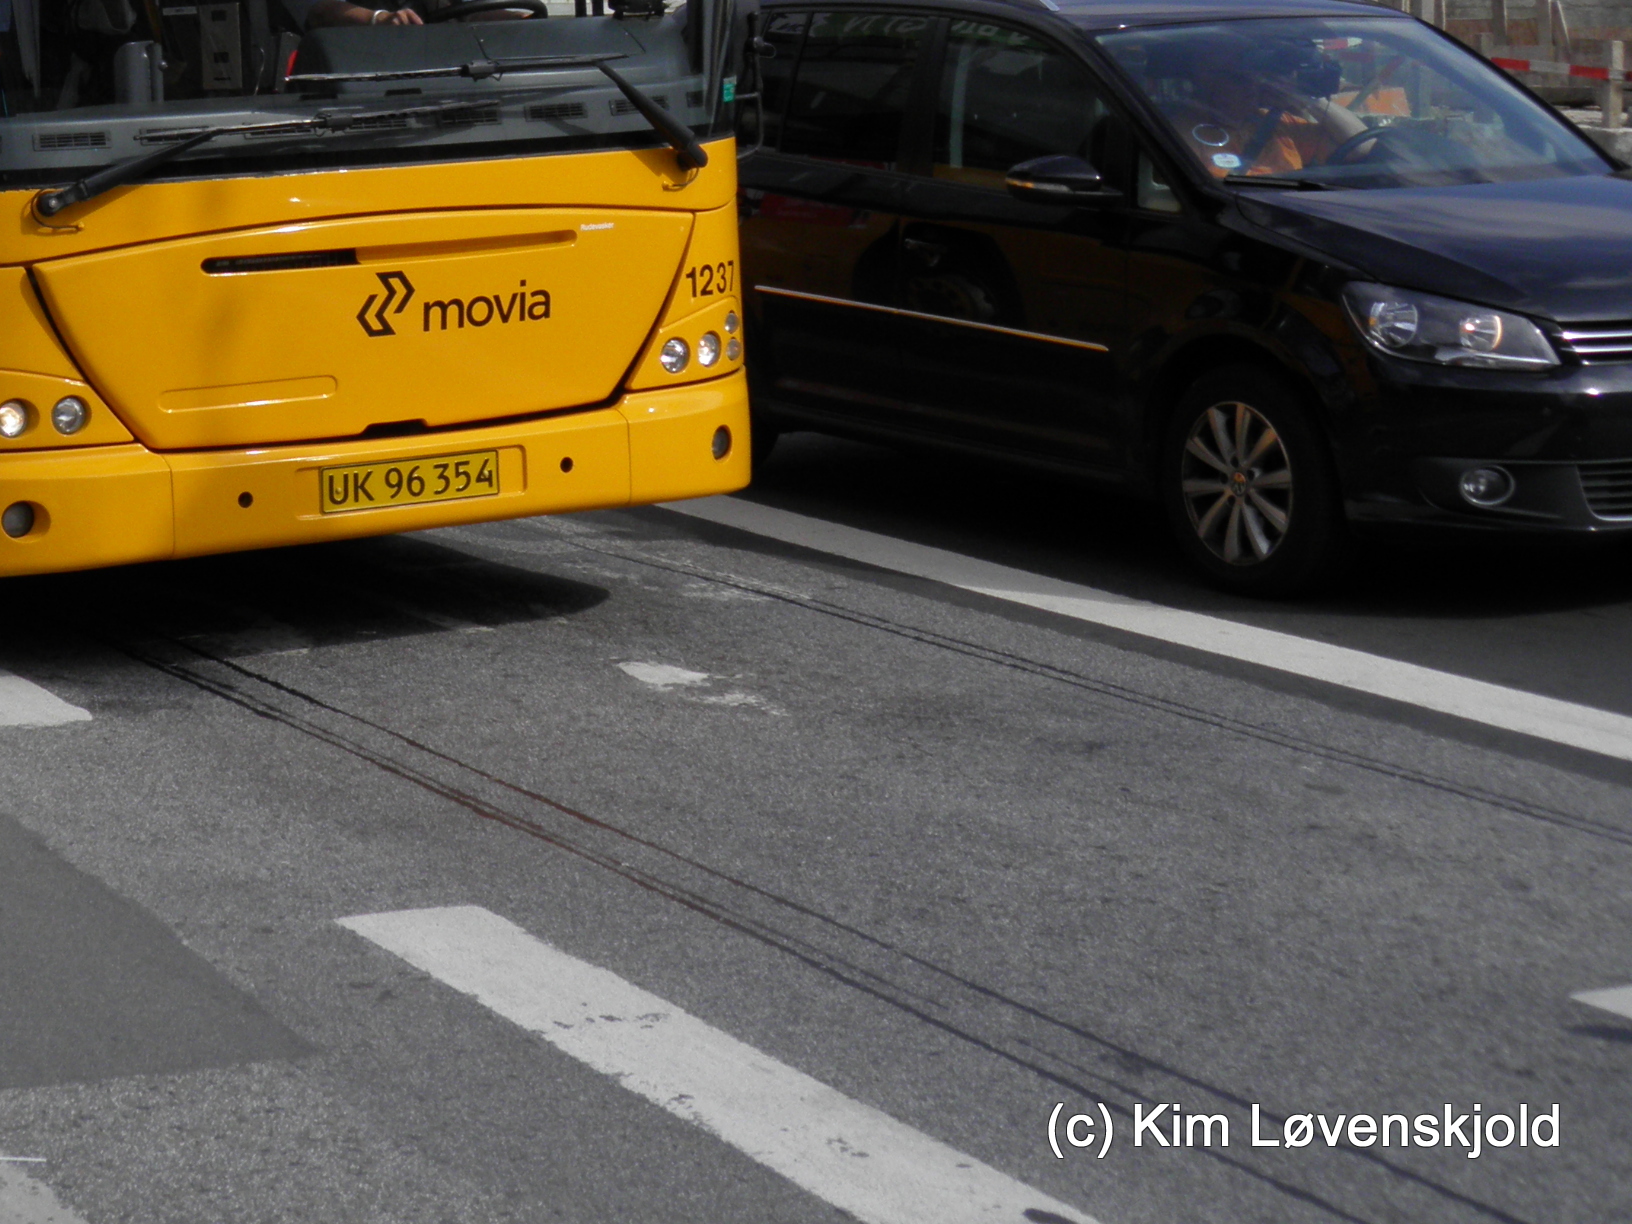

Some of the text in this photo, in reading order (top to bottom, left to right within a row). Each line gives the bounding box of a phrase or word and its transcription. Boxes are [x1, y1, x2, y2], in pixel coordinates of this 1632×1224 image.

[685, 260, 734, 298] 1237
[423, 279, 551, 332] movia
[328, 469, 375, 505] UK
